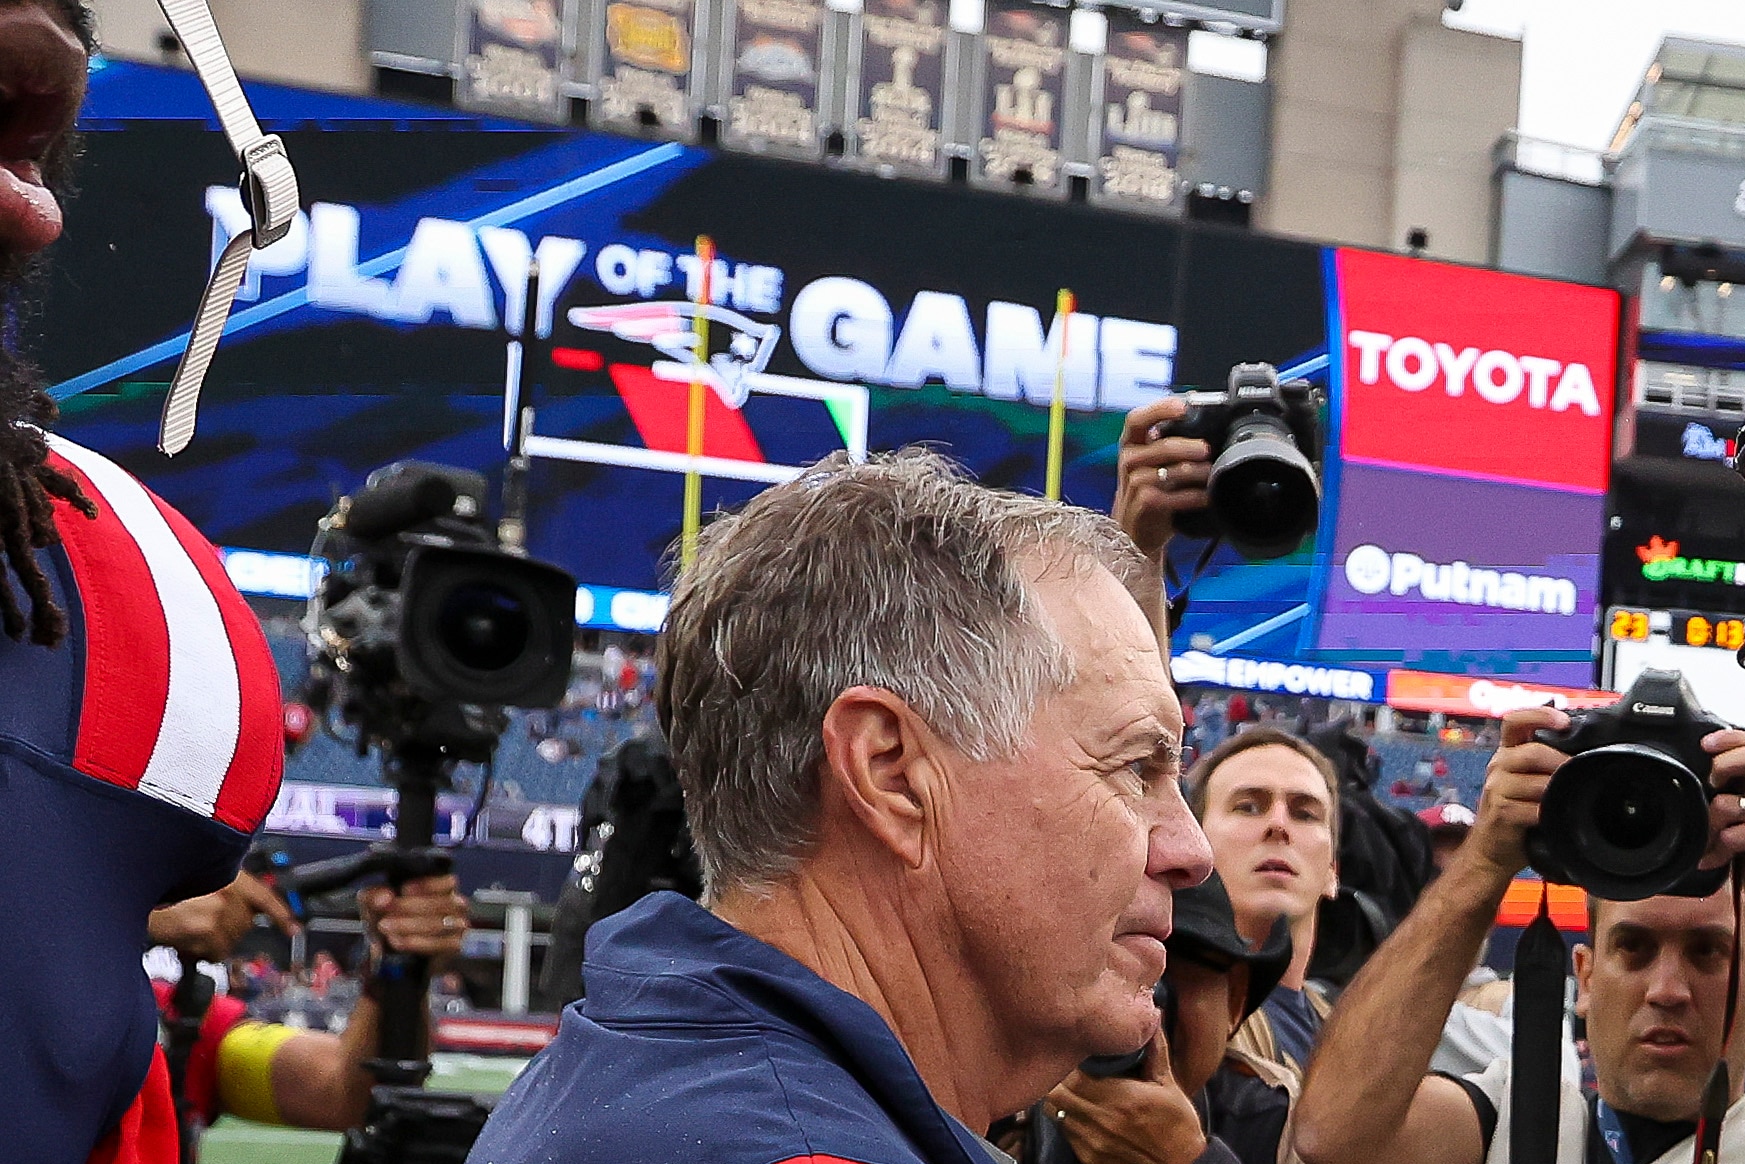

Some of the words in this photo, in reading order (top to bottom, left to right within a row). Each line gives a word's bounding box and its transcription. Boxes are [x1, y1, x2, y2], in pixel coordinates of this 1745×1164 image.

[203, 184, 587, 341] PLAY
[597, 243, 672, 297] OF
[678, 255, 784, 315] THE
[789, 275, 1181, 412] GAME
[1348, 330, 1602, 417] TOYOTA
[1390, 551, 1577, 616] Putnam
[1226, 657, 1374, 701] EMPOWER
[523, 804, 579, 852] 4T
